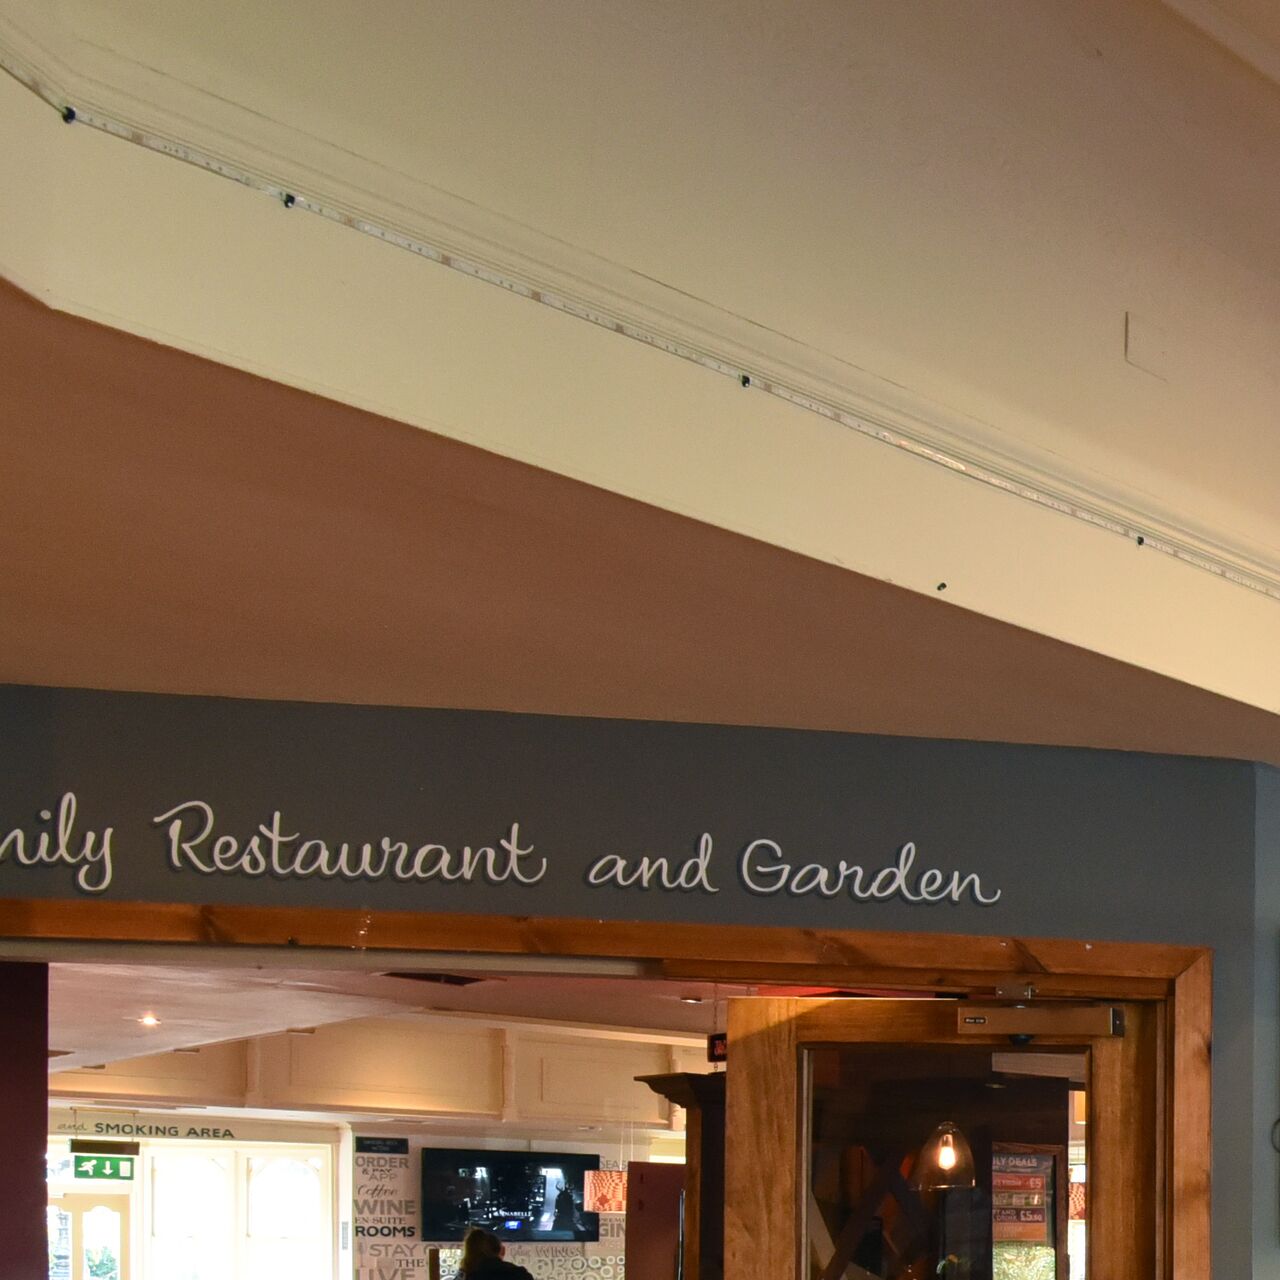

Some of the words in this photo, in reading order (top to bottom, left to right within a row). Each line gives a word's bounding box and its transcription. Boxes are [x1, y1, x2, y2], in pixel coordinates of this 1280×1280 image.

[153, 800, 547, 886] Restaurant
[587, 832, 718, 894] and
[740, 837, 1001, 906] Garden
[94, 1122, 179, 1136] SMOKING
[187, 1127, 235, 1138] AREA
[355, 1156, 409, 1168] ORDER
[368, 1173, 398, 1182] APP
[353, 1200, 416, 1216] WINE
[355, 1226, 416, 1237] ROOMS
[369, 1244, 418, 1257] STAY
[396, 1259, 424, 1268] THE
